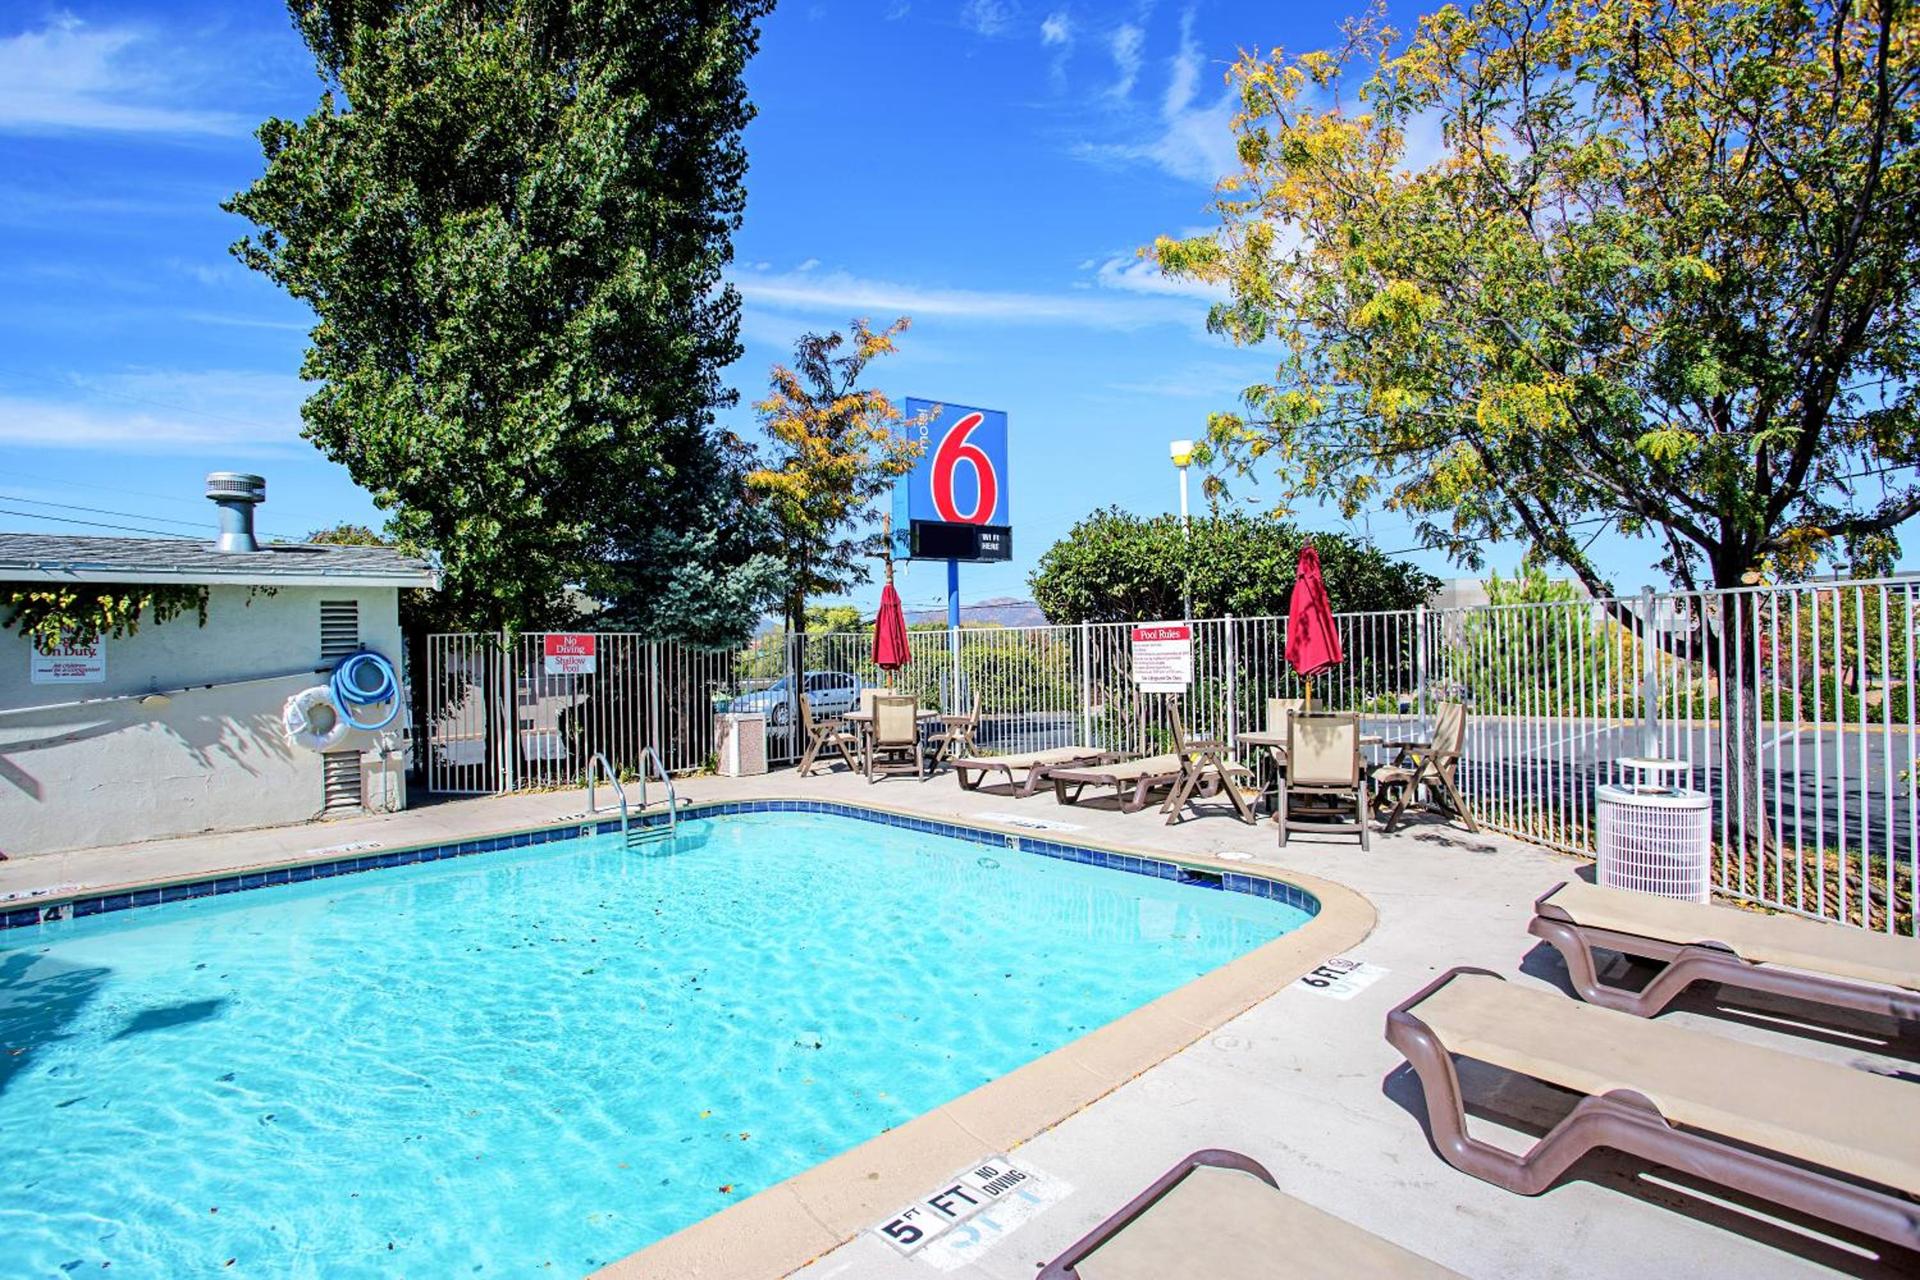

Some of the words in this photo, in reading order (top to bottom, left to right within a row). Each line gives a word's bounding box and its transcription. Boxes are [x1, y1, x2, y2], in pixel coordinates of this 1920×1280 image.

[916, 408, 929, 449] mol
[930, 412, 998, 526] 6
[981, 542, 1000, 550] HERE
[1140, 629, 1157, 640] Pool
[1158, 628, 1182, 639] Rules
[564, 636, 577, 645] No
[556, 645, 586, 655] Diving
[555, 656, 586, 664] Shallow
[562, 664, 580, 672] Pool
[982, 1169, 1027, 1196] DIVING
[881, 1219, 924, 1245] 5
[903, 1207, 921, 1220] FT
[928, 1184, 978, 1217] FT
[974, 1165, 1000, 1180] NO
